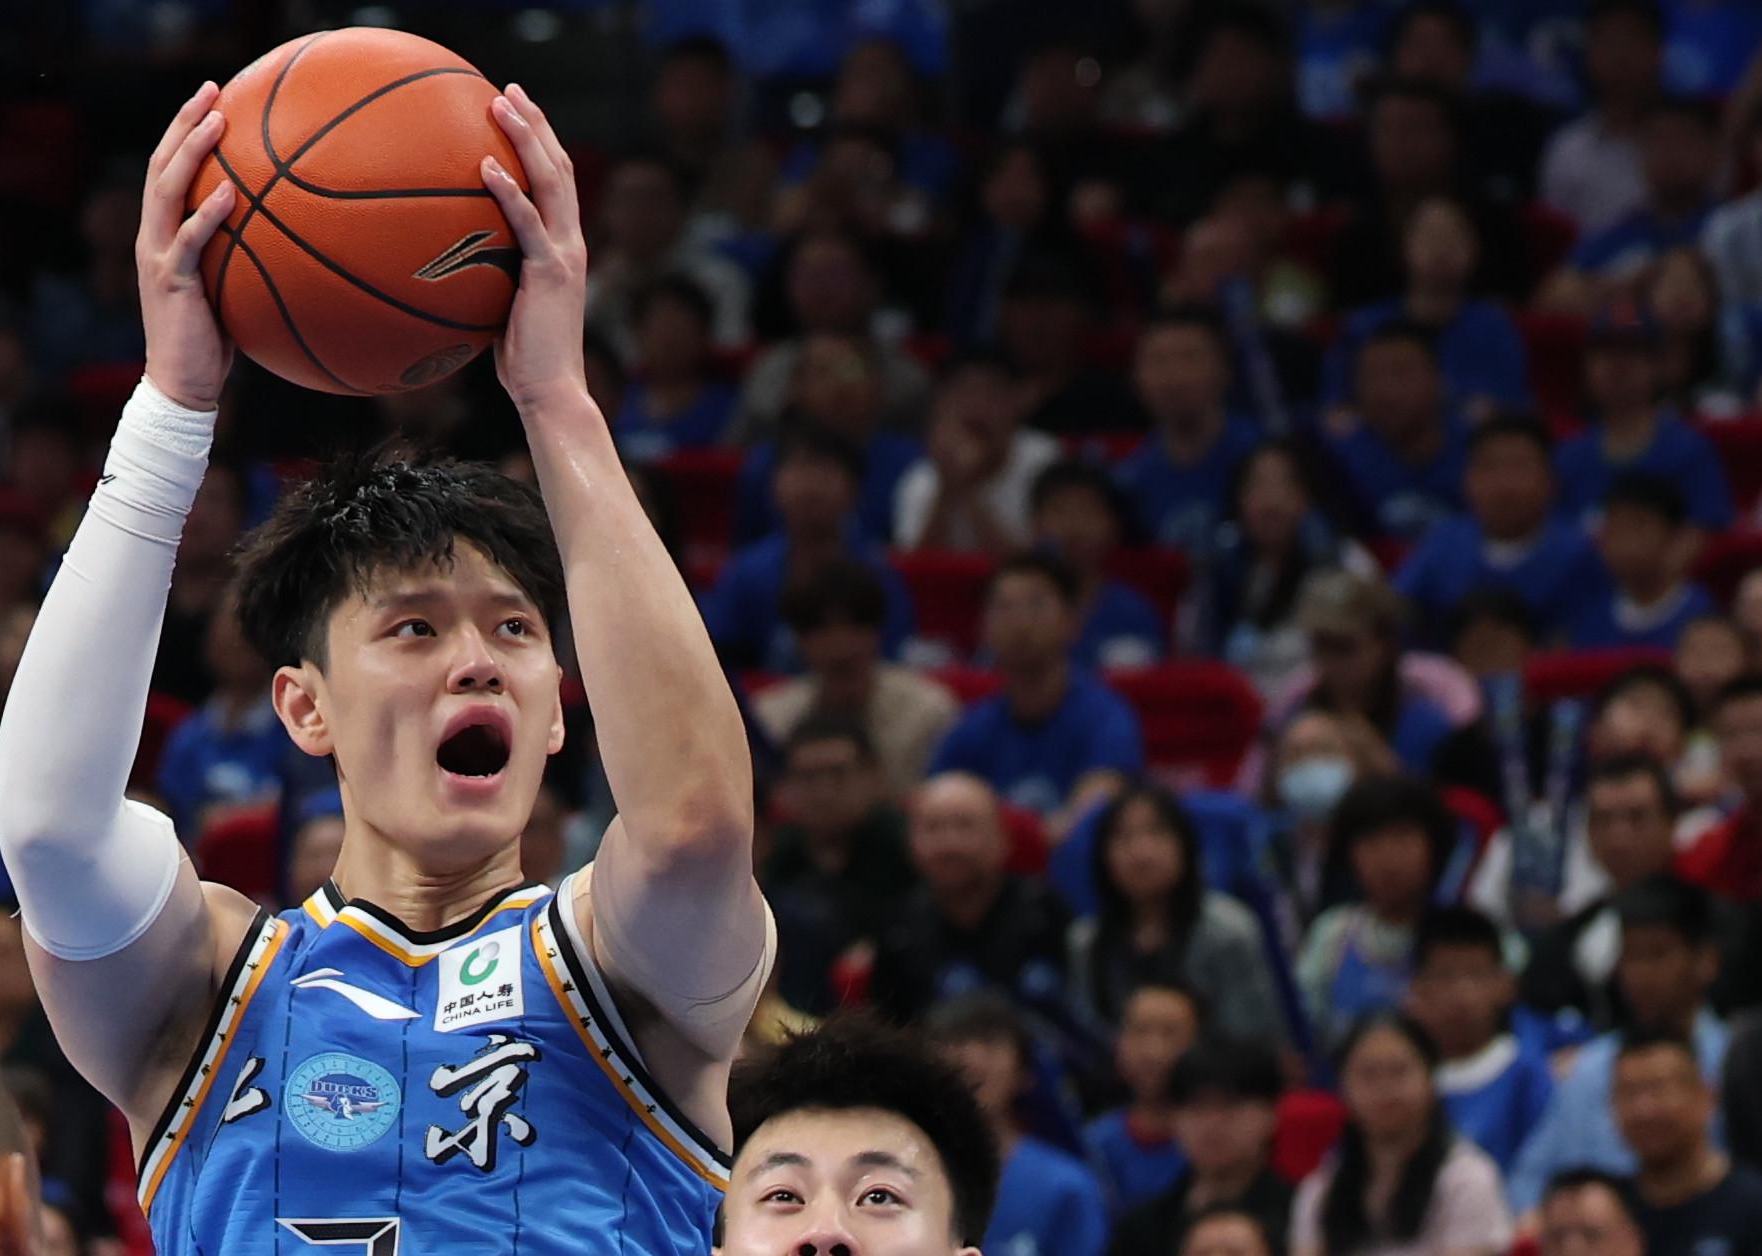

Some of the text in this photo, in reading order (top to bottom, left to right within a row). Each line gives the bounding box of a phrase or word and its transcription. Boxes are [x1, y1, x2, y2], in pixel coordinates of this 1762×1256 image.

[444, 983, 513, 1014] 中国人寿
[442, 999, 514, 1024] CHINA LIFE
[309, 1080, 378, 1099] DUCKS
